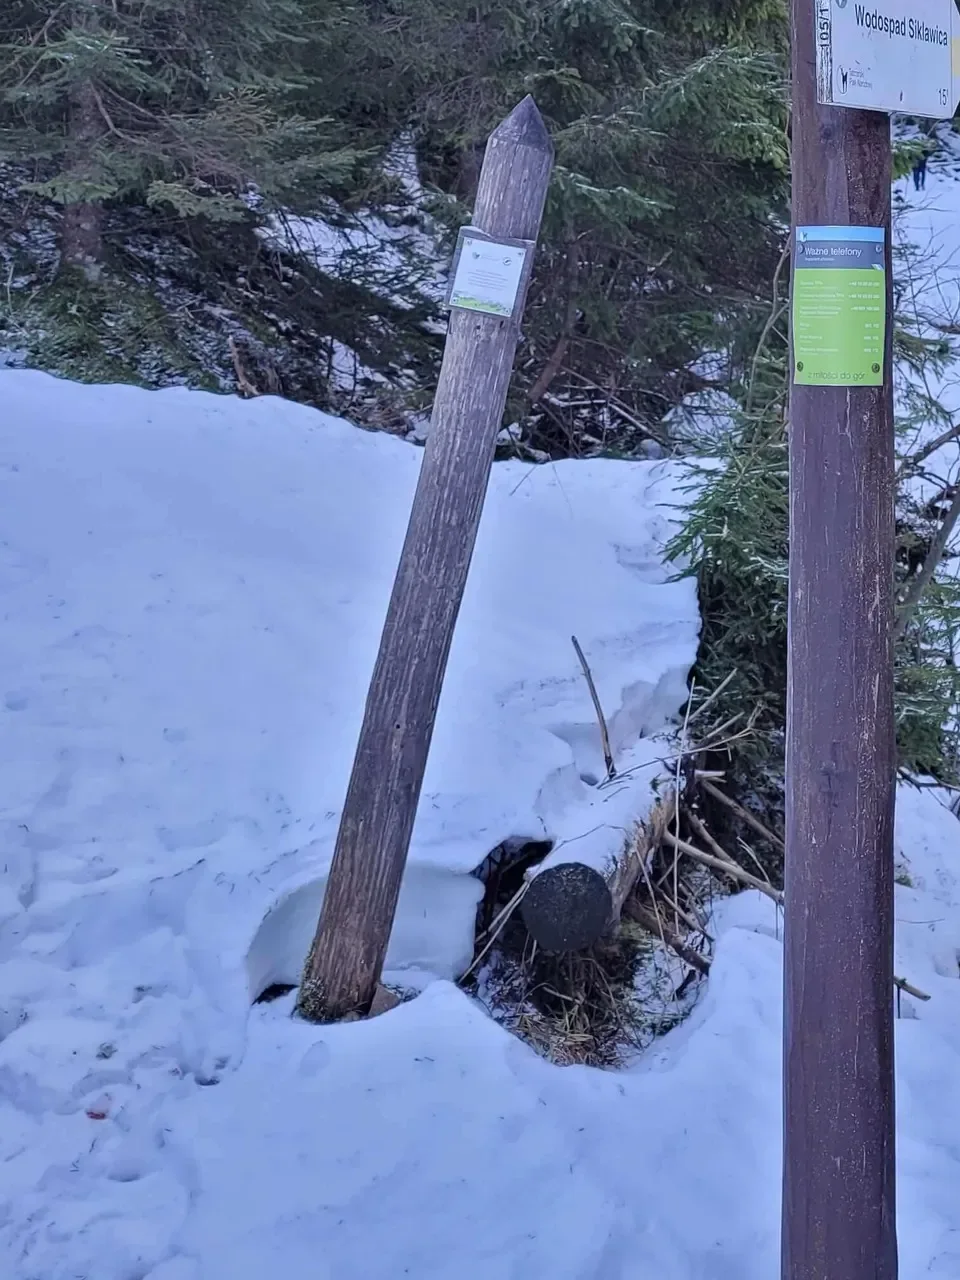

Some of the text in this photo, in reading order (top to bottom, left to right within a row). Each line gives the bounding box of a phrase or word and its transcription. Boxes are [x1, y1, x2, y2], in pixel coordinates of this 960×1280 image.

[854, 3, 948, 46] Wodospad Siklawica
[830, 246, 862, 258] telefony
